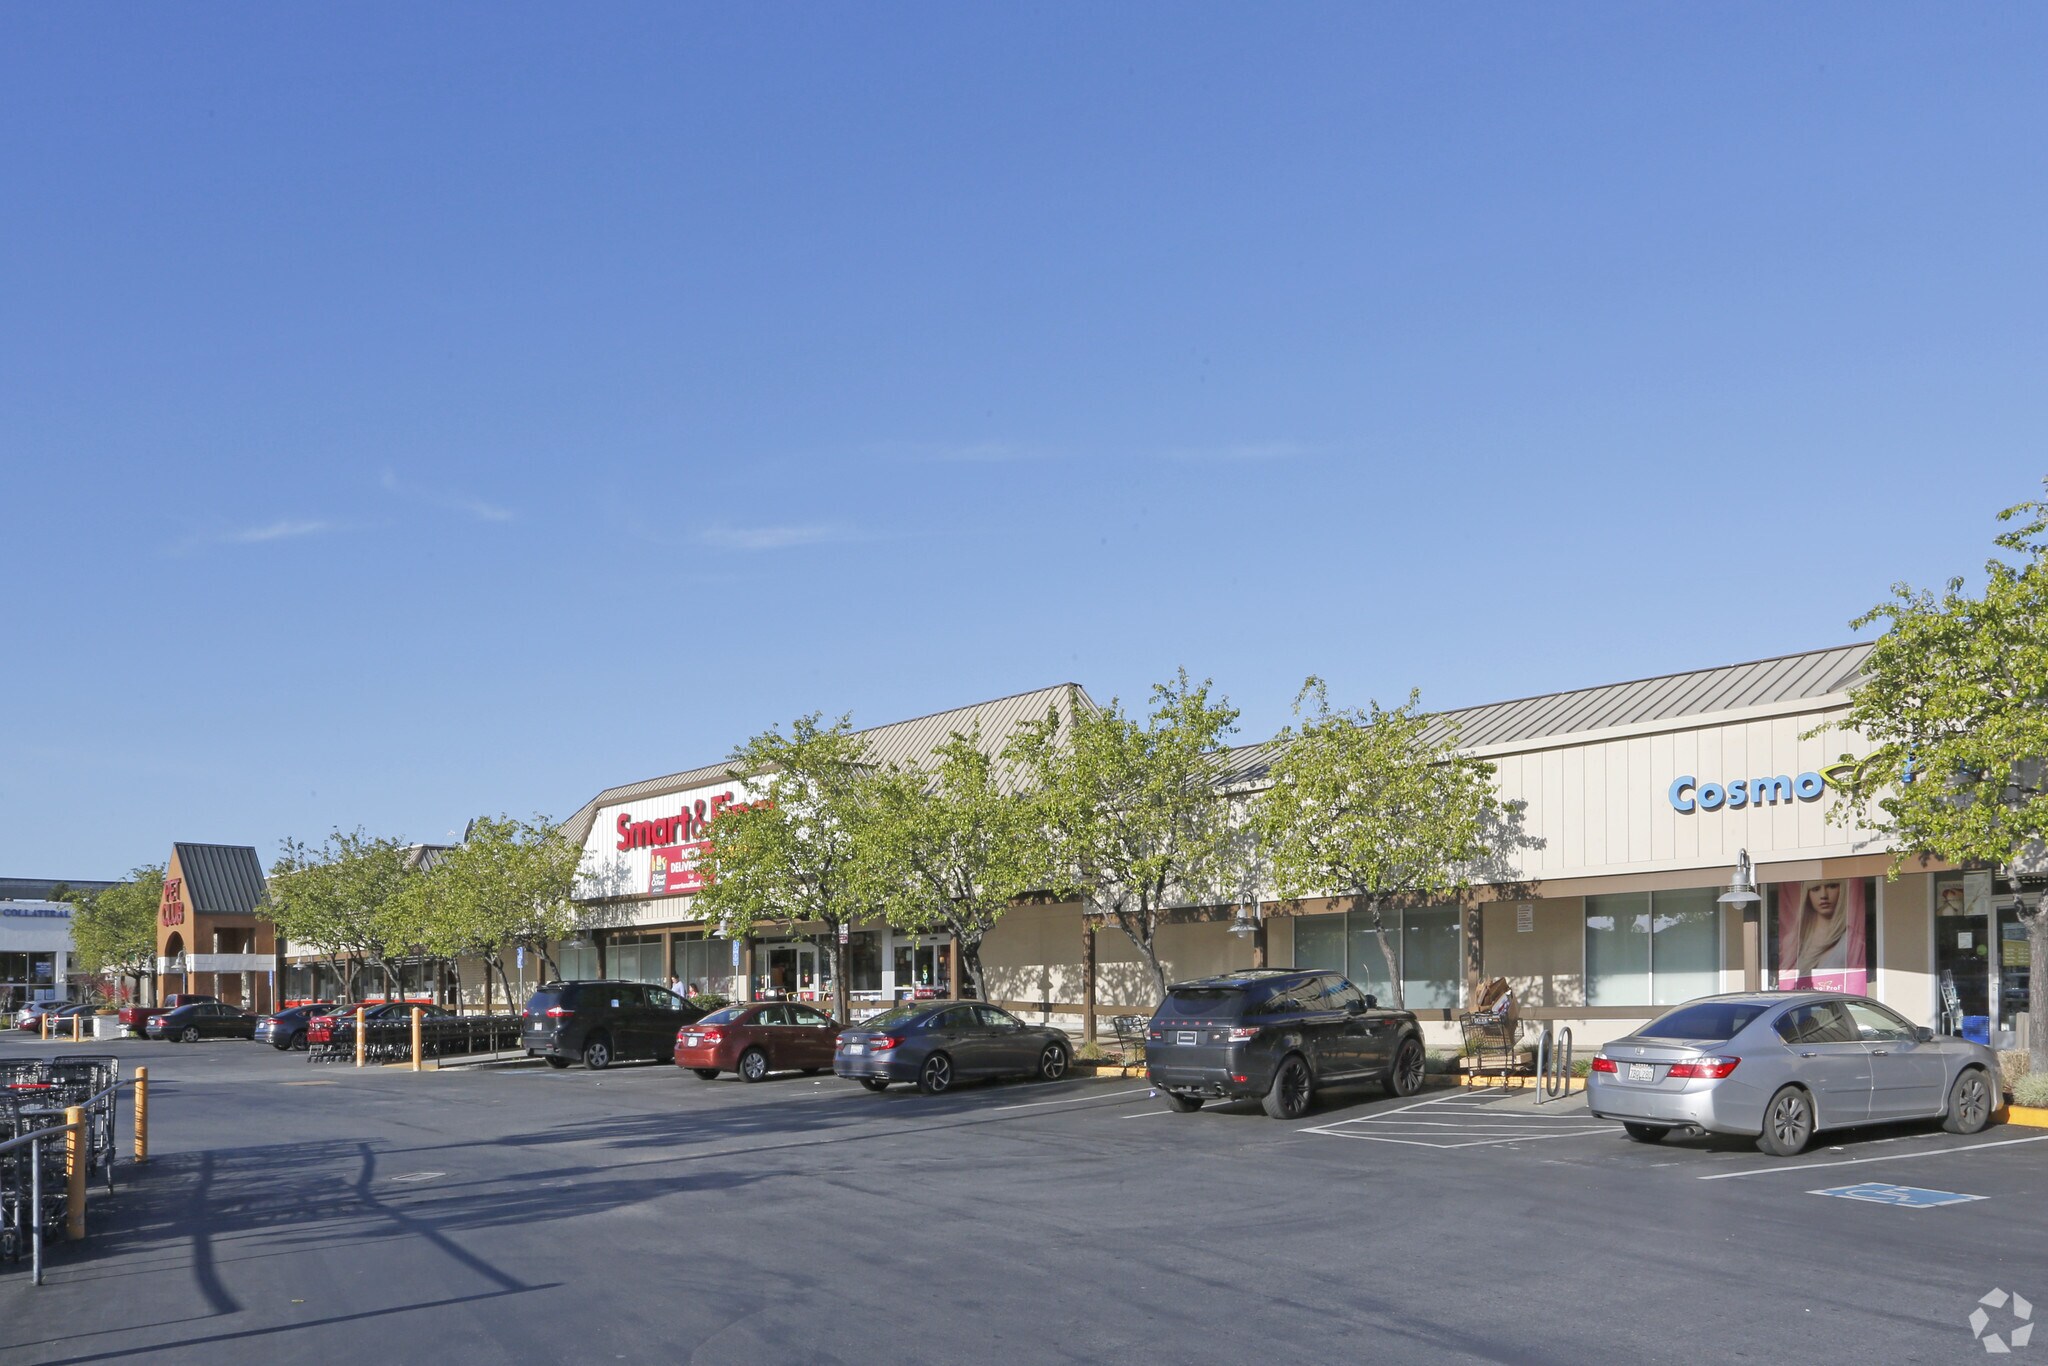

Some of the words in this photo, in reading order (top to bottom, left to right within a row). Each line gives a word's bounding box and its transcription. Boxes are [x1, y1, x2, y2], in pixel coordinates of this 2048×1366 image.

[1669, 771, 1825, 812] Cosmo
[163, 878, 181, 902] PET
[162, 902, 185, 927] CLUB
